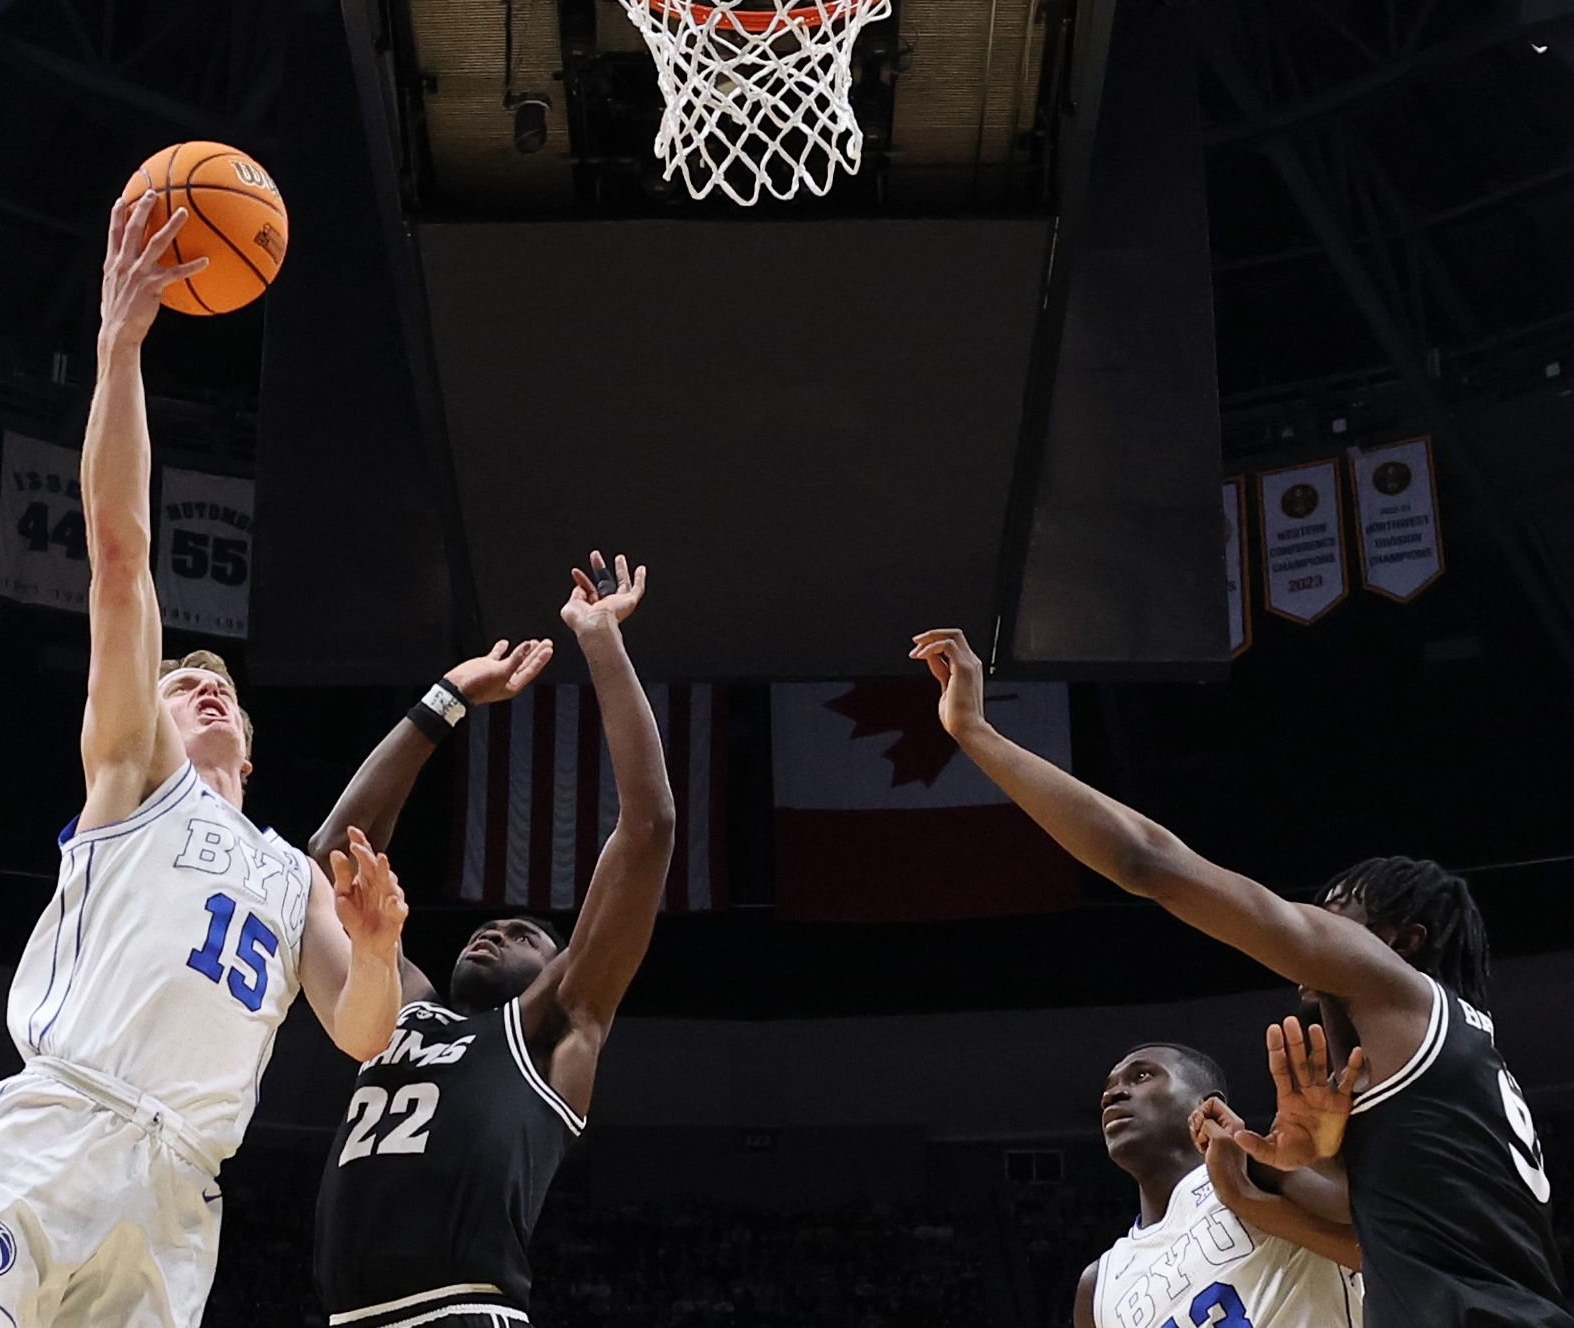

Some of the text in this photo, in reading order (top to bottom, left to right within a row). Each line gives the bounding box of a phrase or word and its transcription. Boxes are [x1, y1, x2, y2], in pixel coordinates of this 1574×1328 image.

[17, 501, 87, 560] 44
[171, 528, 248, 586] 55
[186, 892, 279, 1012] 15
[358, 1028, 476, 1076] AMS
[338, 1082, 441, 1168] 22
